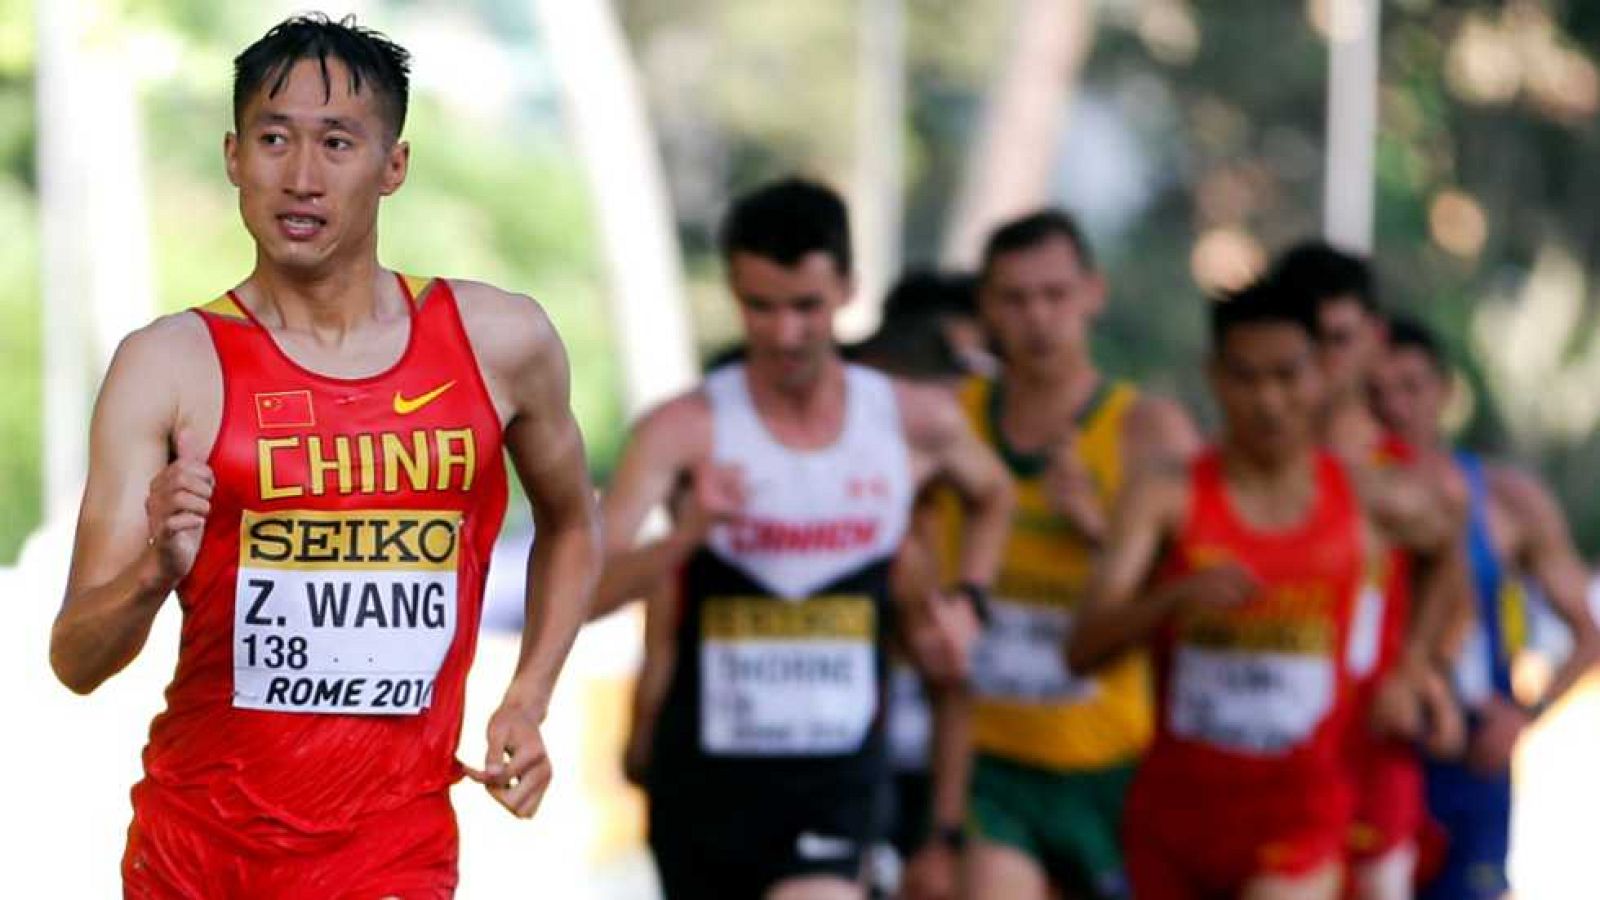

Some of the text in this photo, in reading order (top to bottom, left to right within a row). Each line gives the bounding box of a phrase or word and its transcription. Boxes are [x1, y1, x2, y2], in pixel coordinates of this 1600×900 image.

[257, 427, 476, 500] CHINA
[250, 519, 457, 563] SEIKO
[245, 580, 446, 628] Z. WANG
[242, 634, 309, 669] 138
[265, 677, 367, 707] ROME
